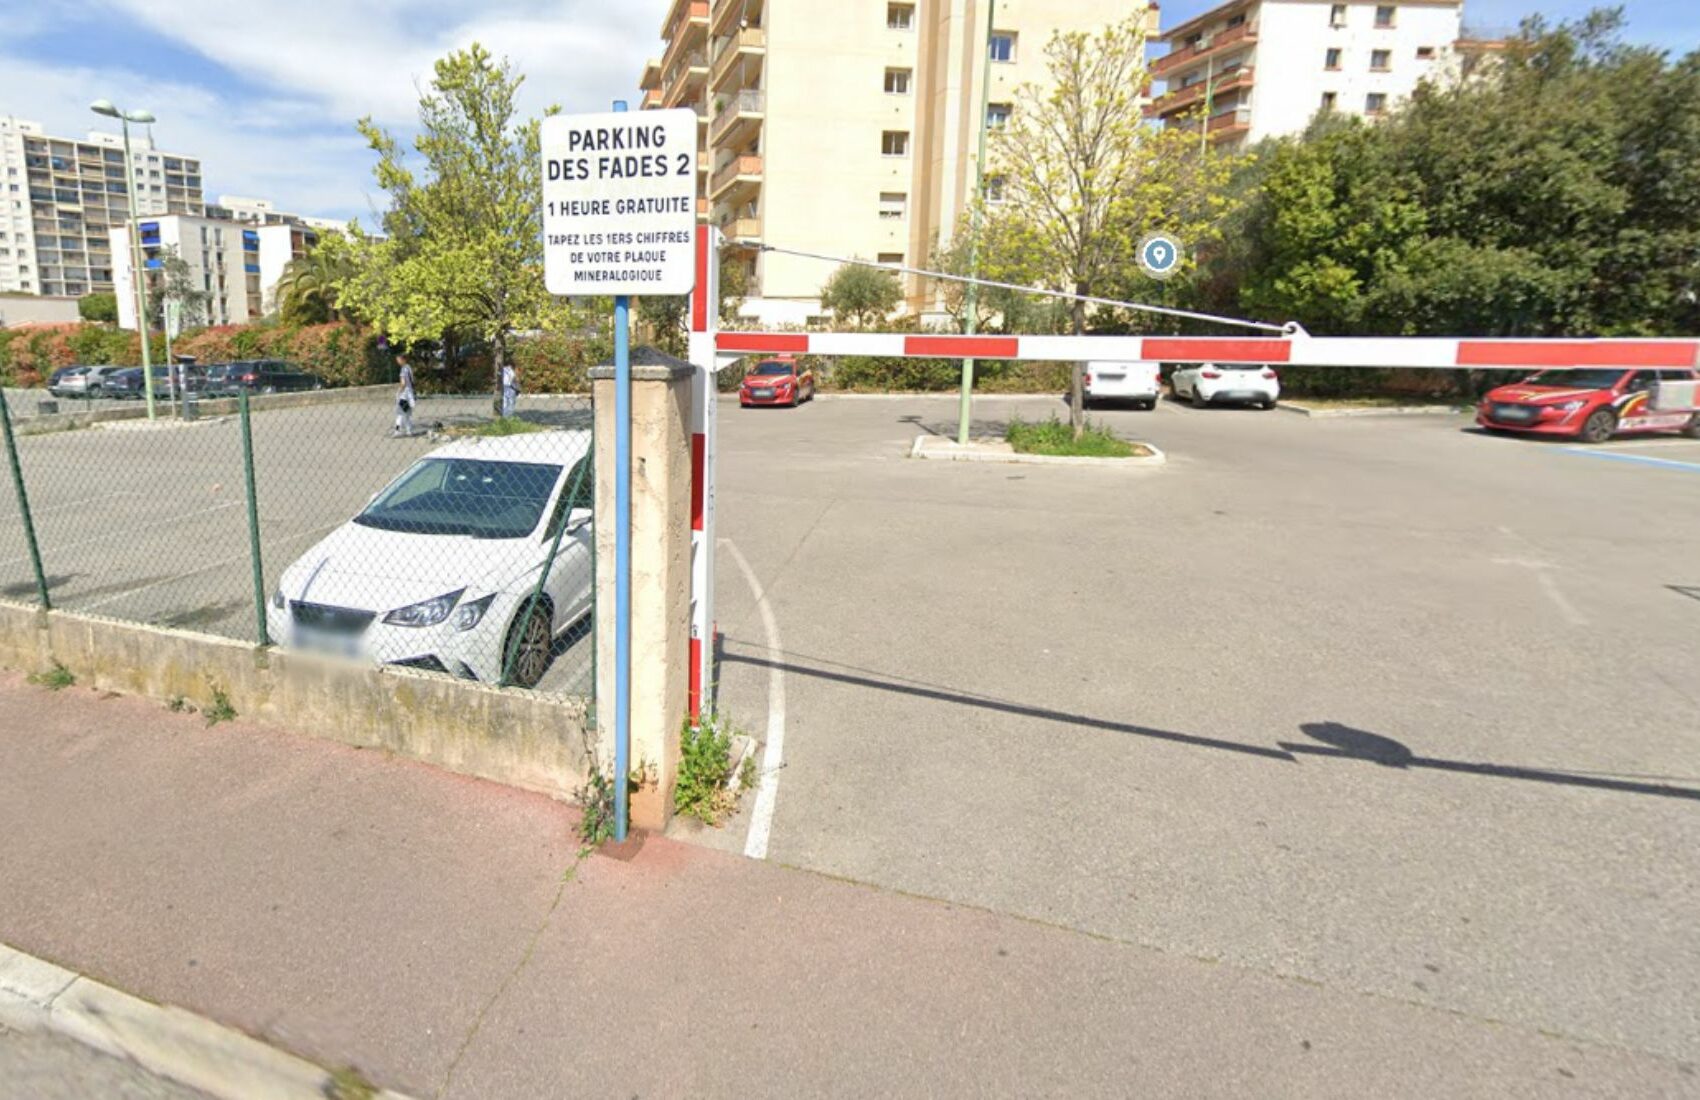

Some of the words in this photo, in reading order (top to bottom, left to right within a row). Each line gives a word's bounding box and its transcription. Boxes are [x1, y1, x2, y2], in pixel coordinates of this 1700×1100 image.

[568, 125, 666, 152] PARKING
[548, 158, 589, 181] DES
[598, 155, 668, 179] FADES
[676, 153, 690, 176] 2
[548, 202, 555, 216] 1
[560, 199, 610, 216] HEURE
[616, 197, 689, 214] GRATUITE
[548, 234, 580, 246] TAPEZ
[584, 233, 603, 245] LES
[607, 232, 633, 244] 1ERS
[637, 231, 690, 244] CHIFFRES
[570, 252, 583, 263] DE
[588, 251, 621, 263] VOTRE
[625, 250, 666, 262] PLAQUE
[574, 269, 662, 282] MINERALOGIQUE
